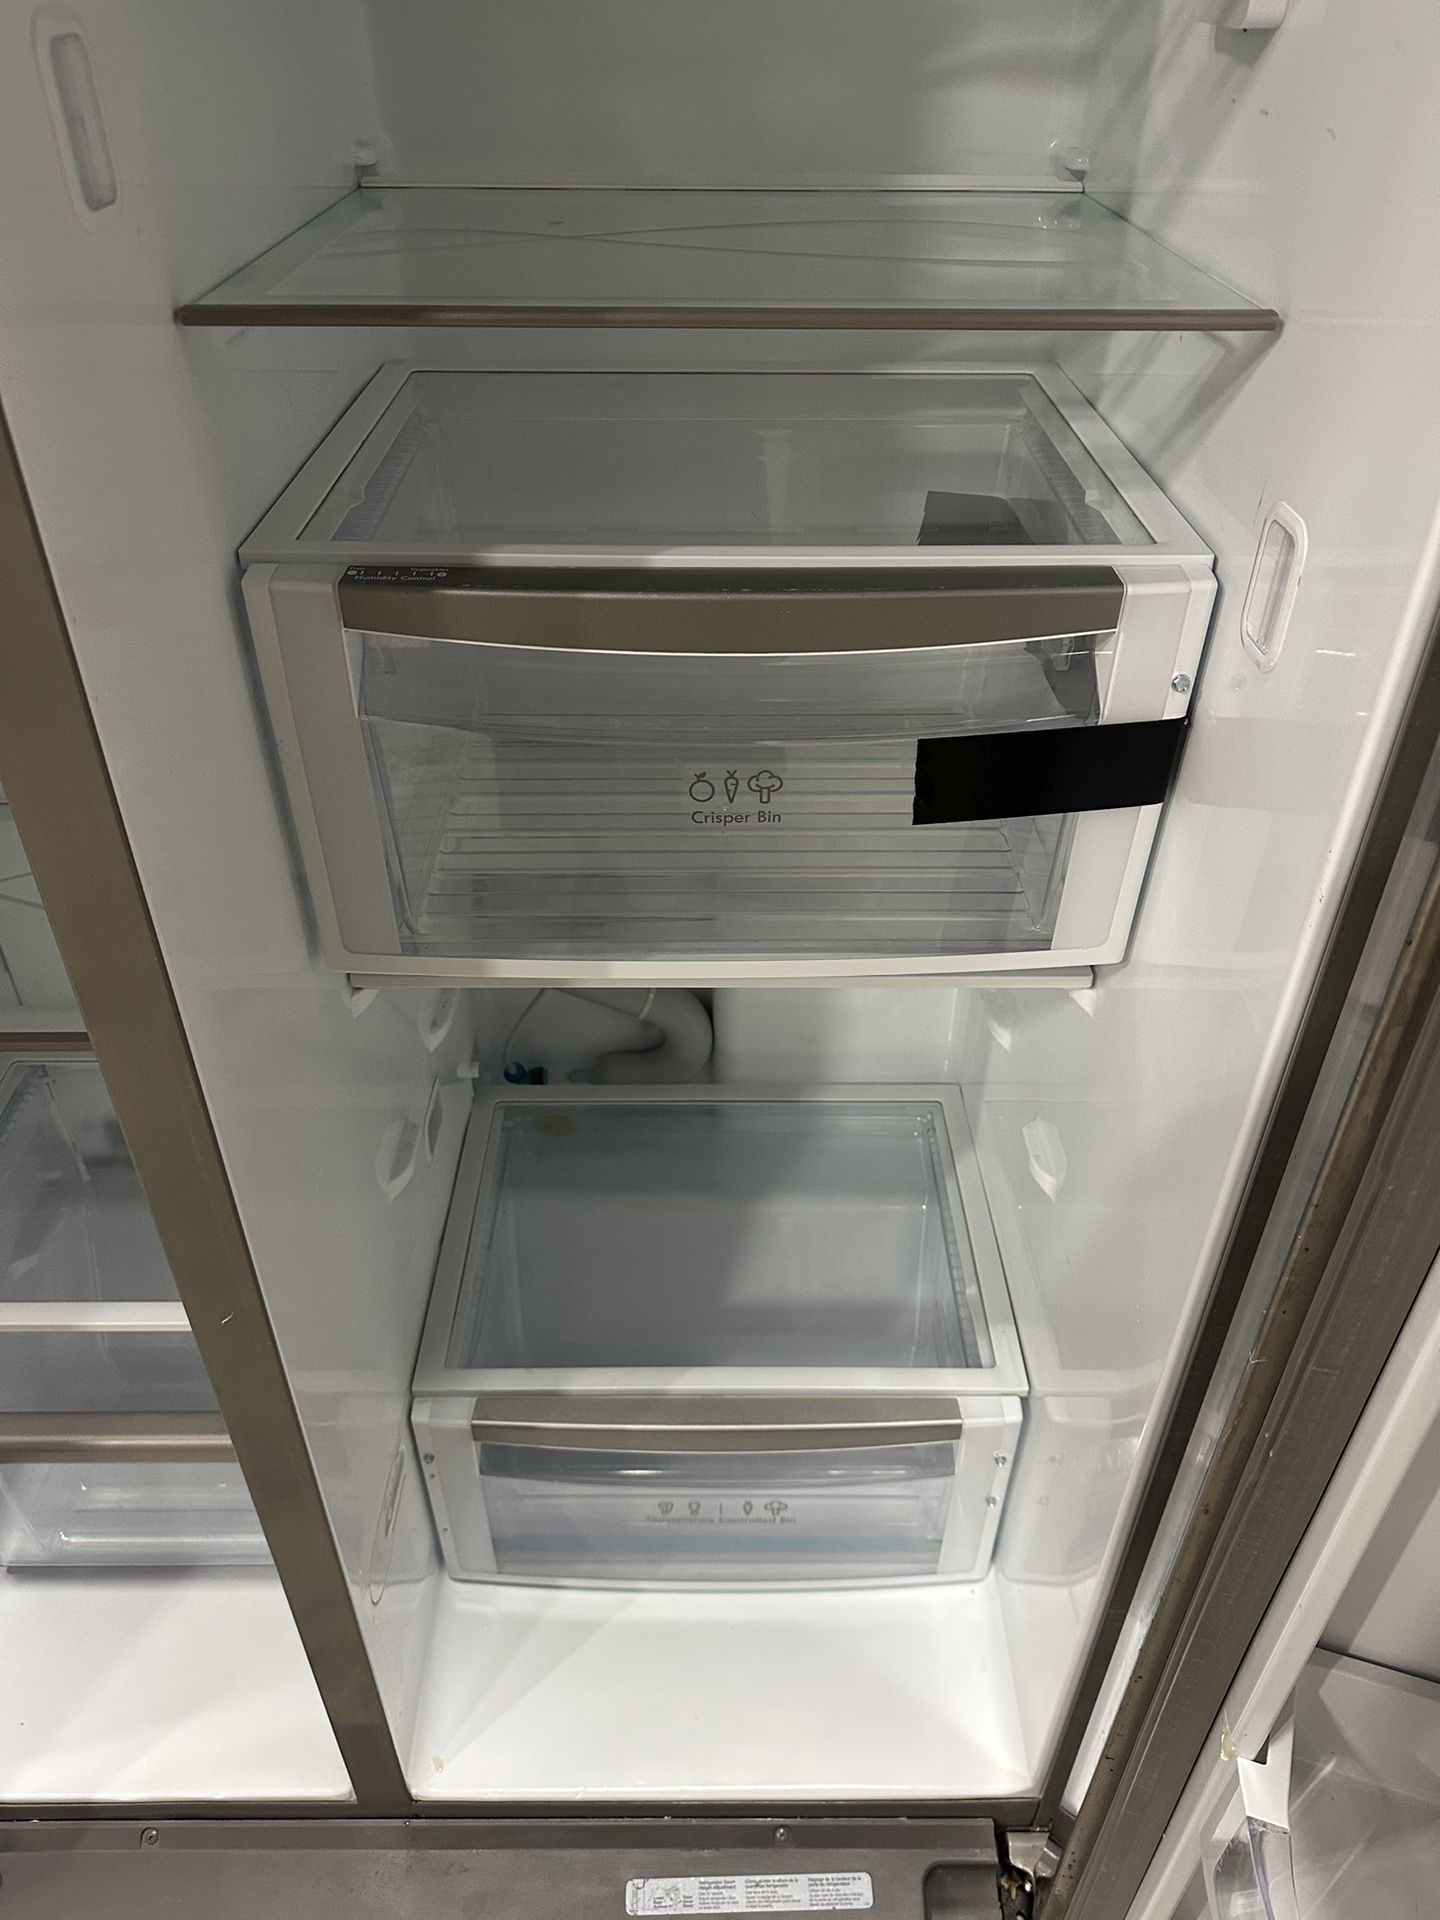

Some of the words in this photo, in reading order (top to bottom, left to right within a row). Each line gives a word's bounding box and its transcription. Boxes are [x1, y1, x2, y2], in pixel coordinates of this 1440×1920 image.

[692, 810, 751, 826] Crisper
[757, 810, 781, 823] Bin
[780, 1516, 797, 1524] Bin
